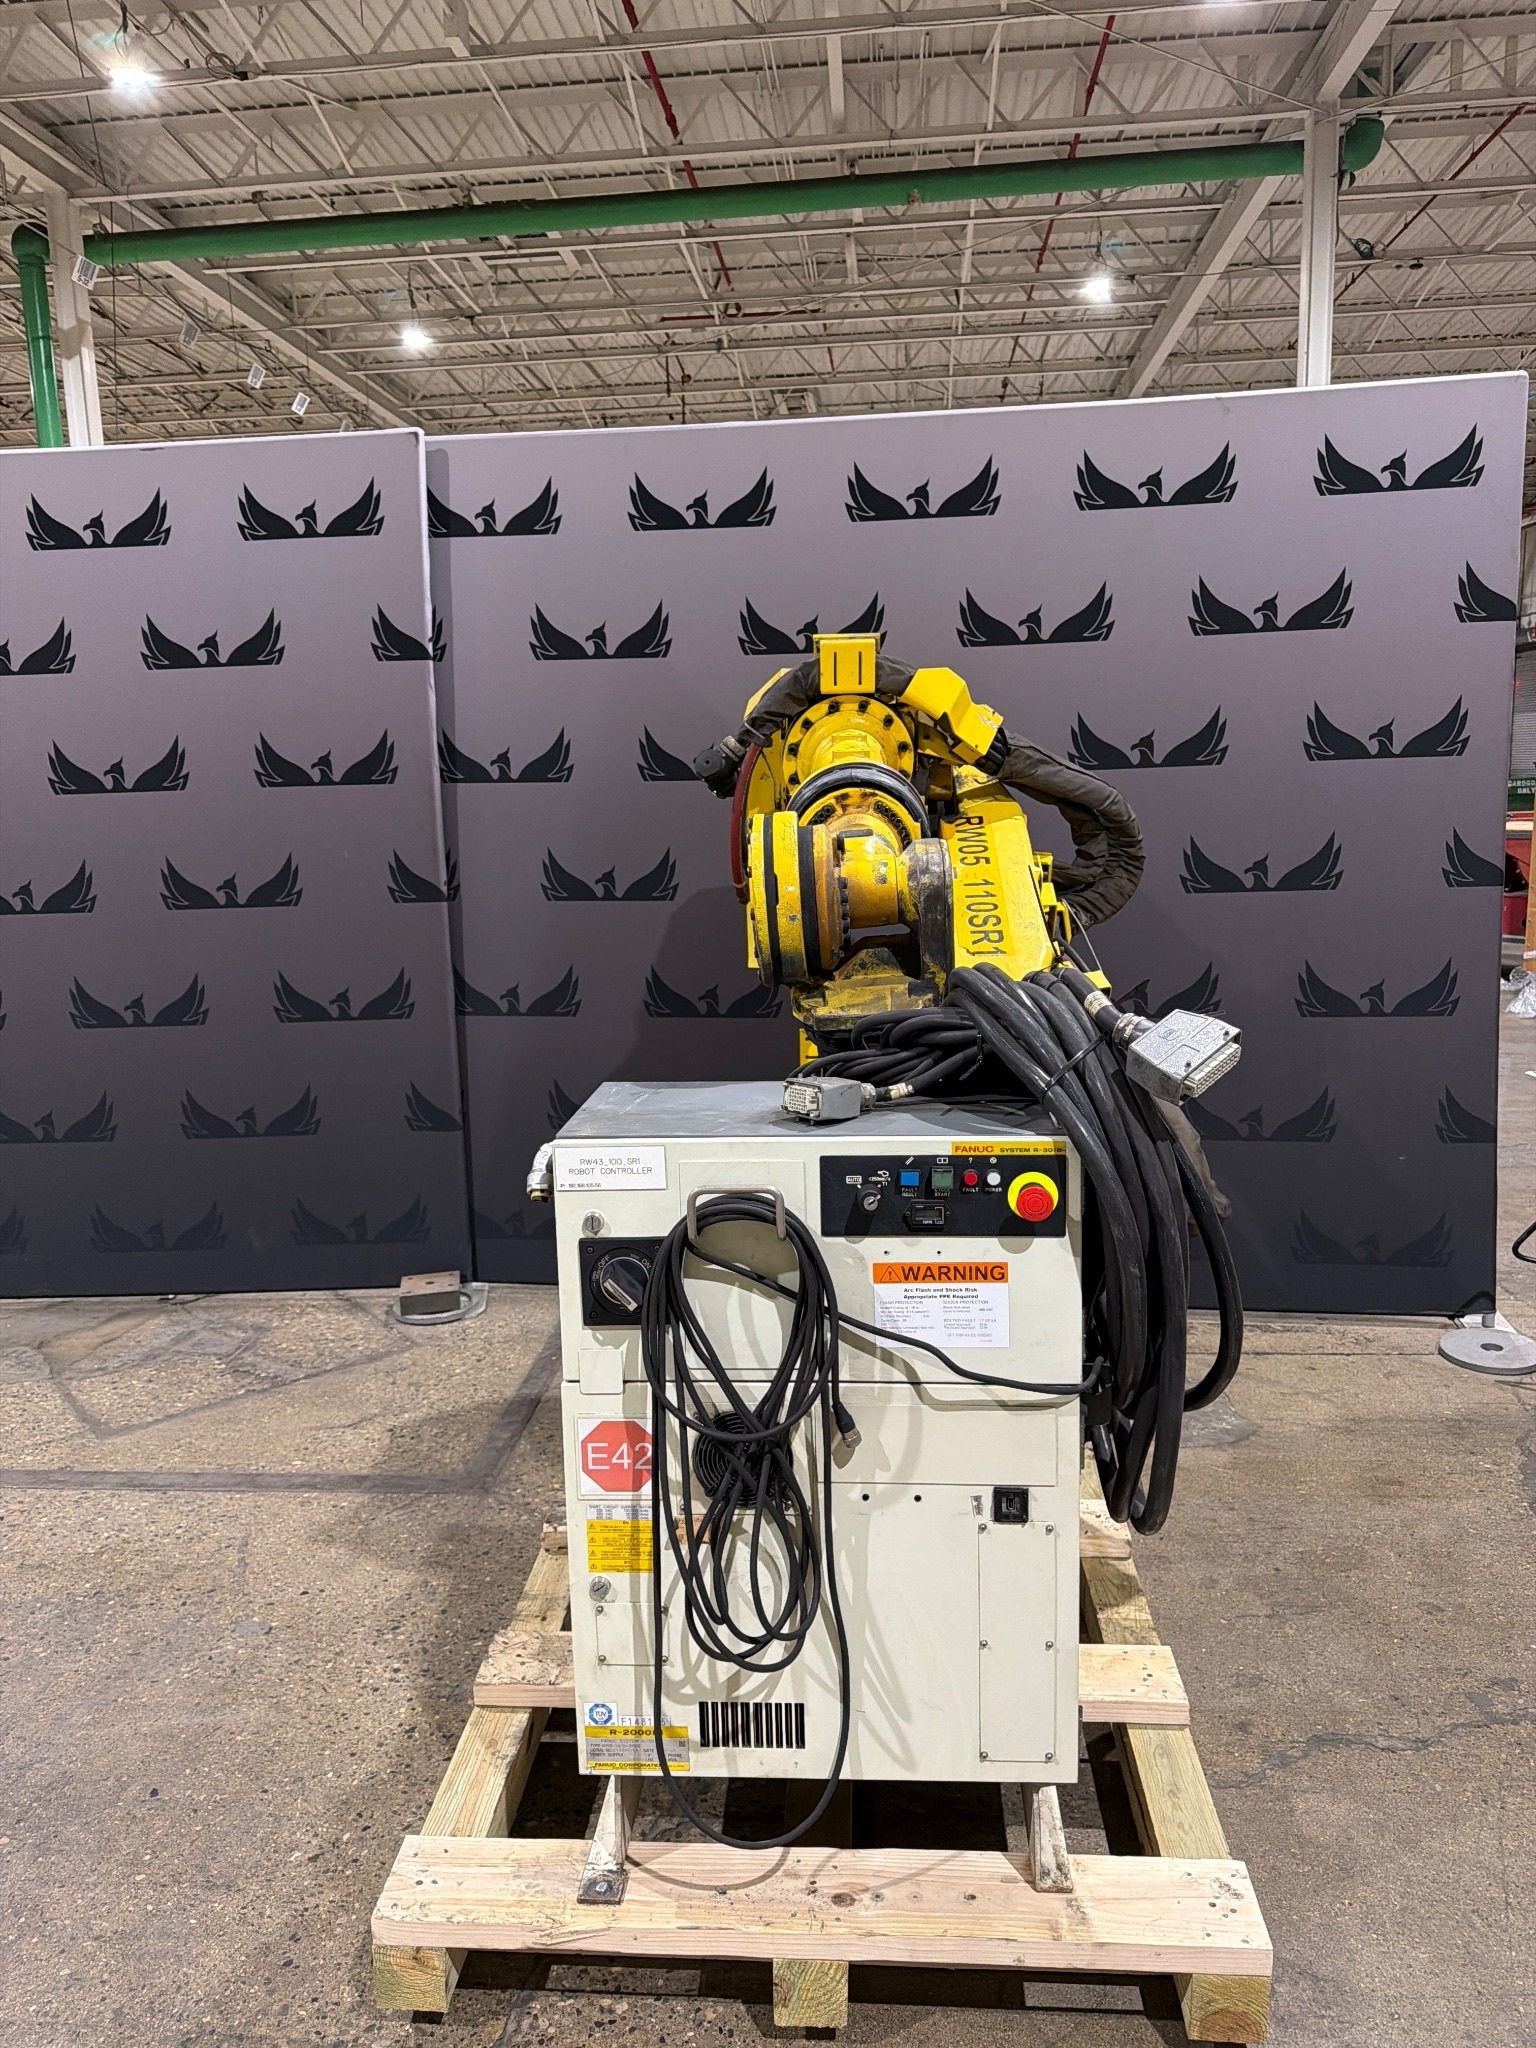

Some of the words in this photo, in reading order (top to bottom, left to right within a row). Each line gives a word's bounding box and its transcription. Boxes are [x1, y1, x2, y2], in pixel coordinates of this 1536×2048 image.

[600, 1167, 652, 1175] CONTROLLER
[642, 1259, 652, 1269] ON
[901, 1265, 1005, 1281] WARNING
[587, 1442, 652, 1470] E42
[621, 1717, 666, 1726] F14815
